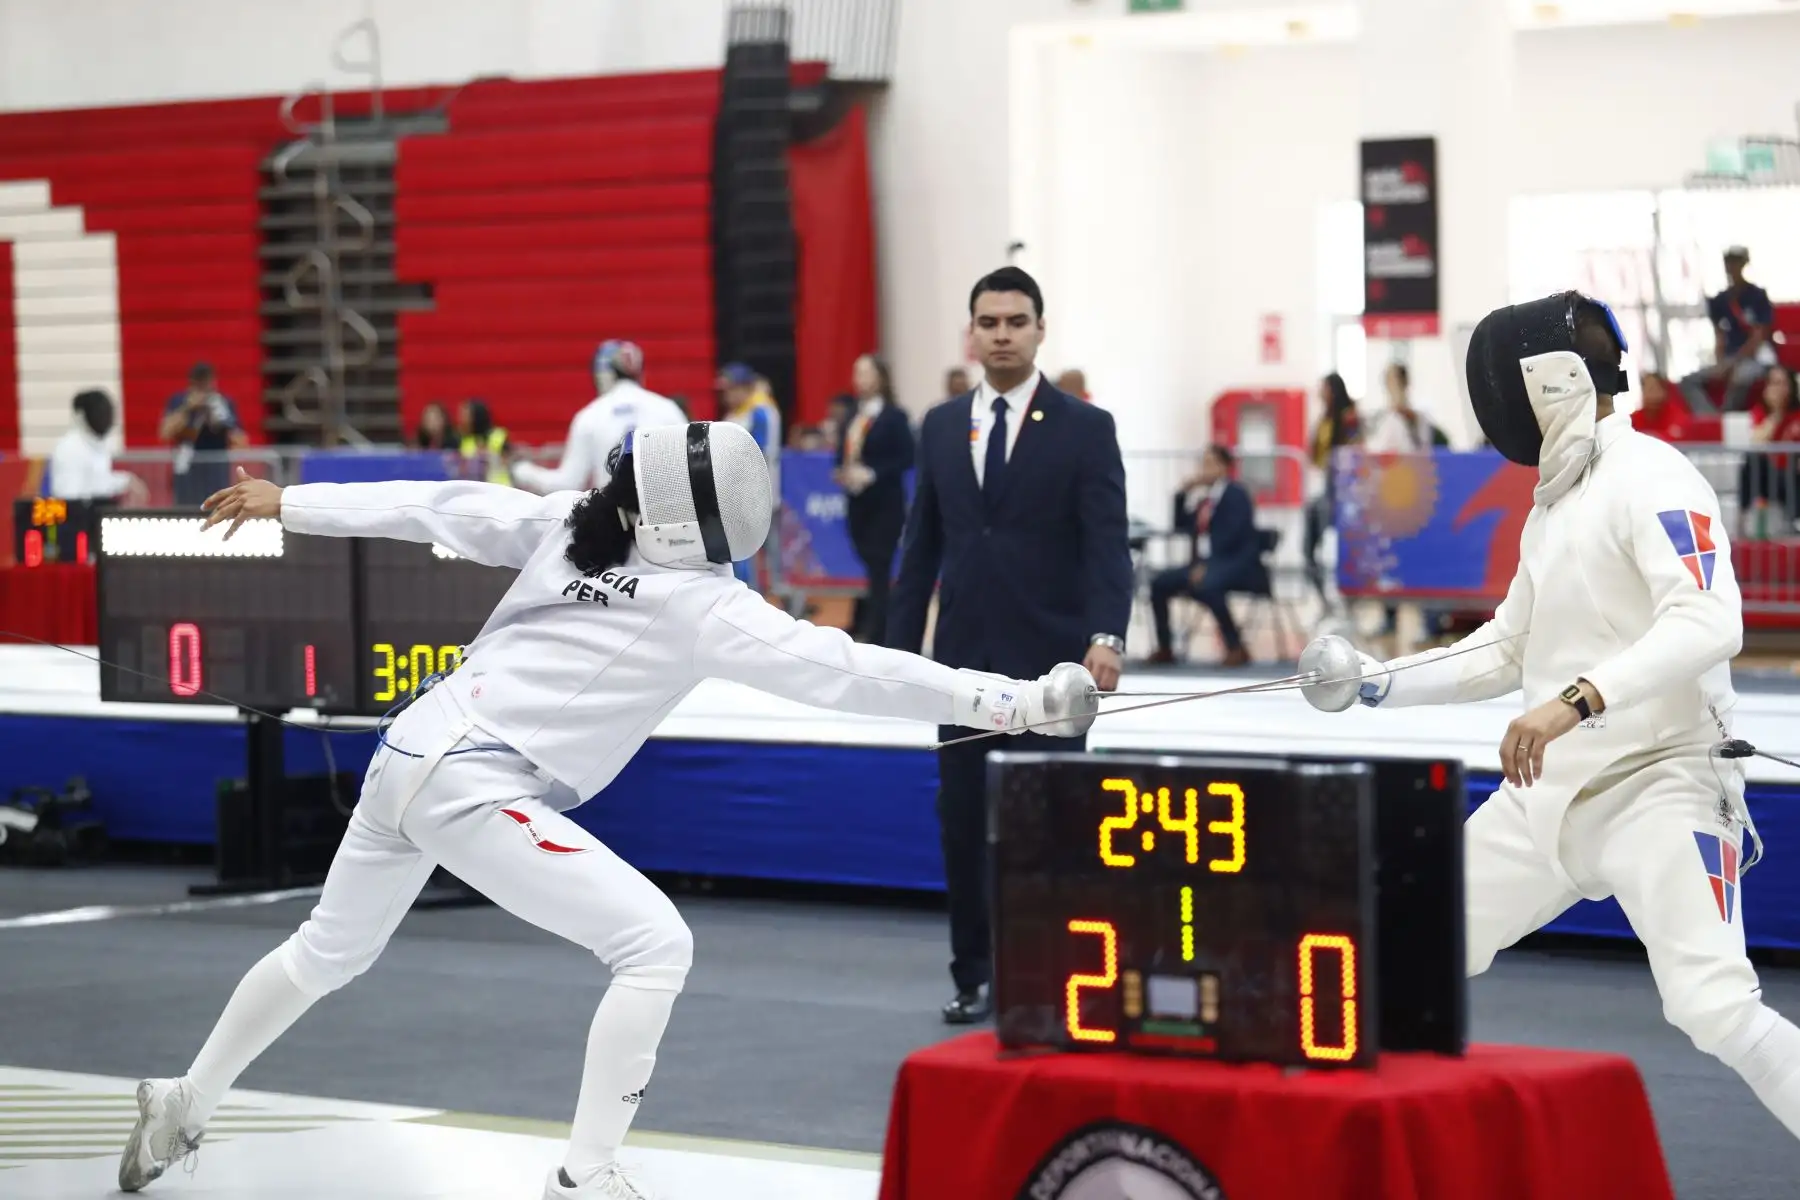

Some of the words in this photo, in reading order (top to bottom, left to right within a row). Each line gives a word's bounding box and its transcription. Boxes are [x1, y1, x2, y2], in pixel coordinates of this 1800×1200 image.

[561, 579, 609, 608] PER
[169, 623, 201, 696] 0
[304, 645, 316, 697] 1
[1099, 778, 1246, 873] 2:43
[1180, 886, 1195, 962] 1
[1066, 919, 1118, 1042] 2
[1298, 933, 1358, 1062] 0
